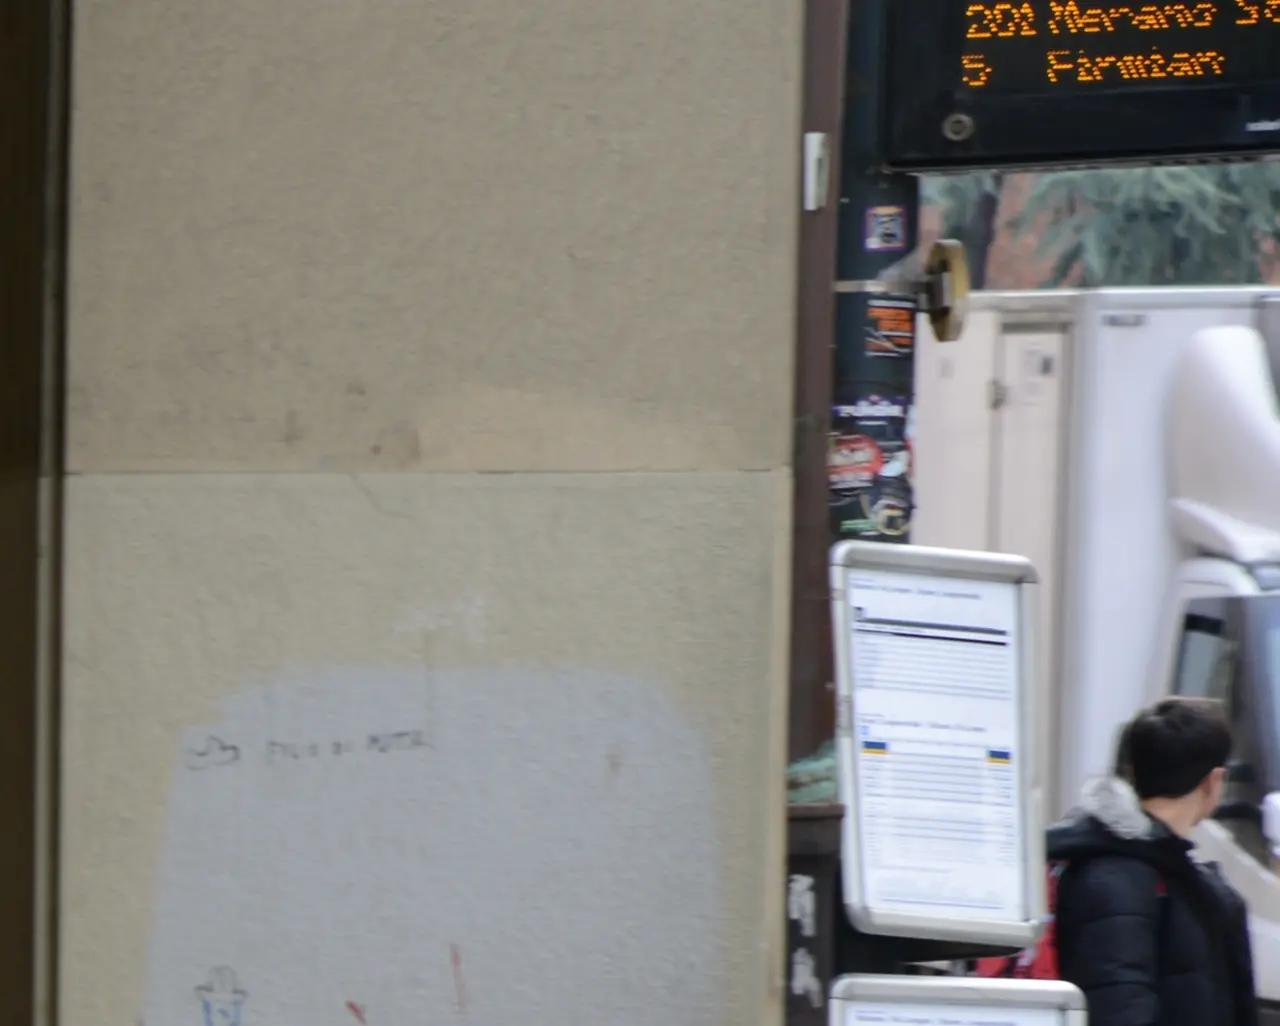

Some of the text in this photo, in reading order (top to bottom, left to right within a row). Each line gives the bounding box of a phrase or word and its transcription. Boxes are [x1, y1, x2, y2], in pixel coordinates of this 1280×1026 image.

[966, 2, 1037, 38] 201
[1047, 0, 1218, 35] Merano
[961, 46, 1225, 87] 5 Firmian
